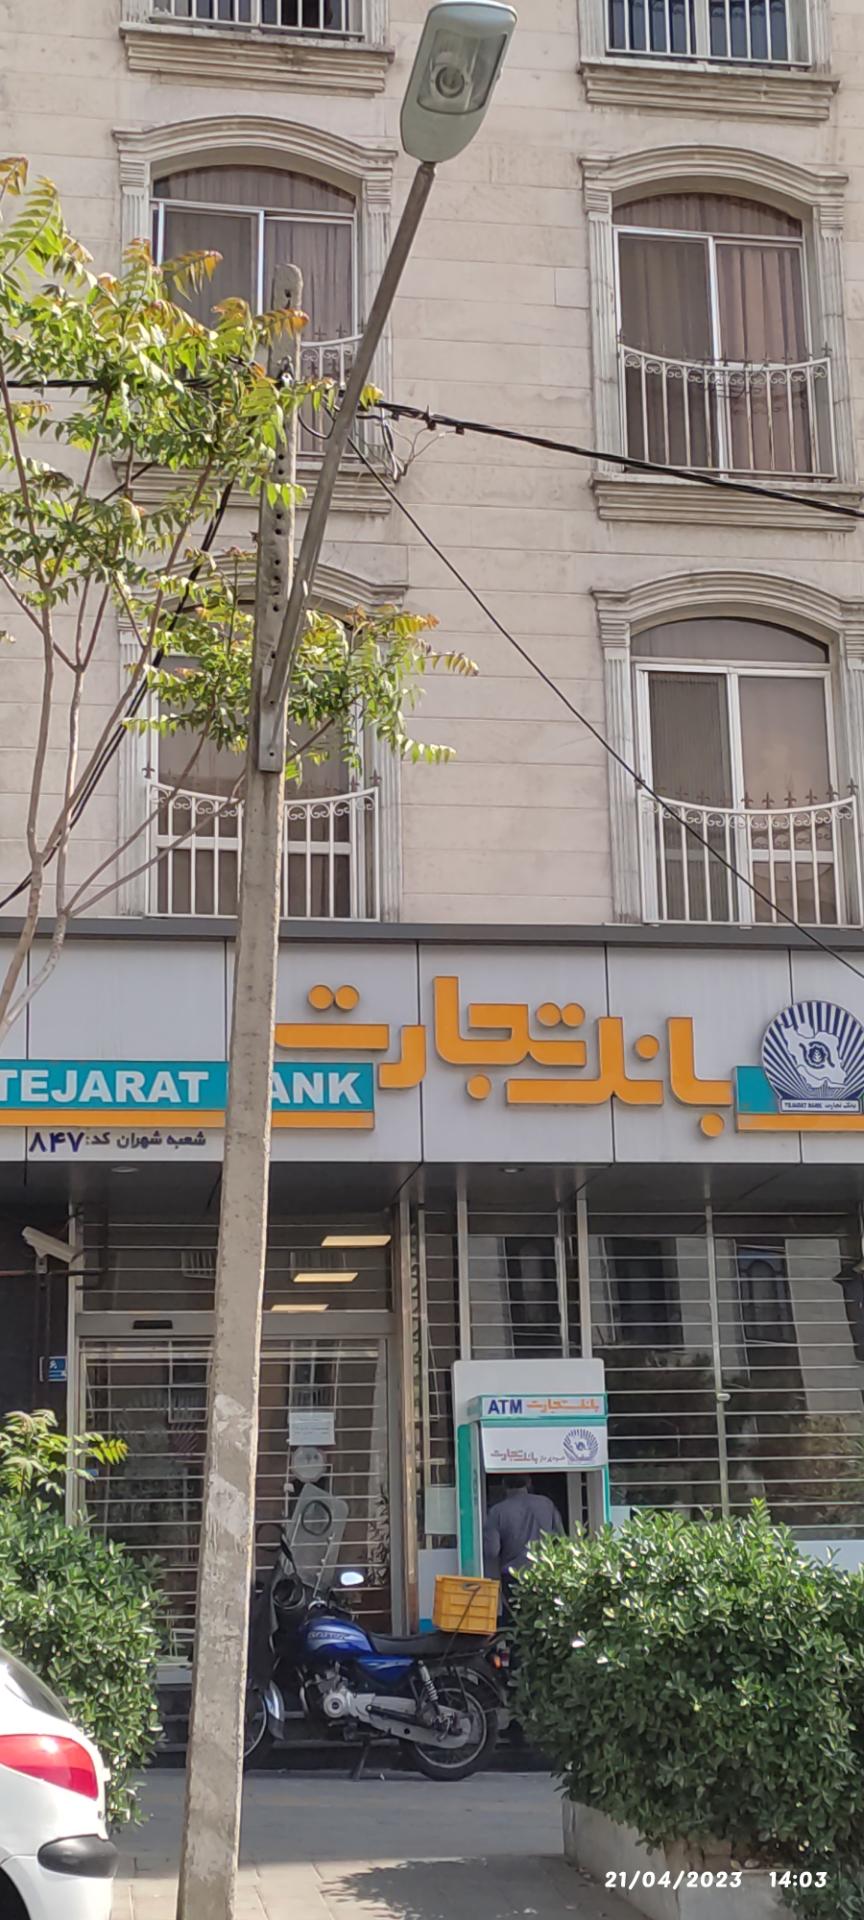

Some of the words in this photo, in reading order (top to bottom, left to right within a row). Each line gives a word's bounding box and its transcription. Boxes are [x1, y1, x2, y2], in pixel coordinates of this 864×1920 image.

[274, 976, 586, 1100] تجارت
[0, 1069, 209, 1103] TEJARAT
[227, 1072, 362, 1104] ANK
[505, 1016, 733, 1138] بانک
[29, 1131, 84, 1153] ۸۴۷
[116, 1131, 162, 1149] شهران
[166, 1130, 206, 1149] شعبه
[488, 1399, 522, 1415] ATM
